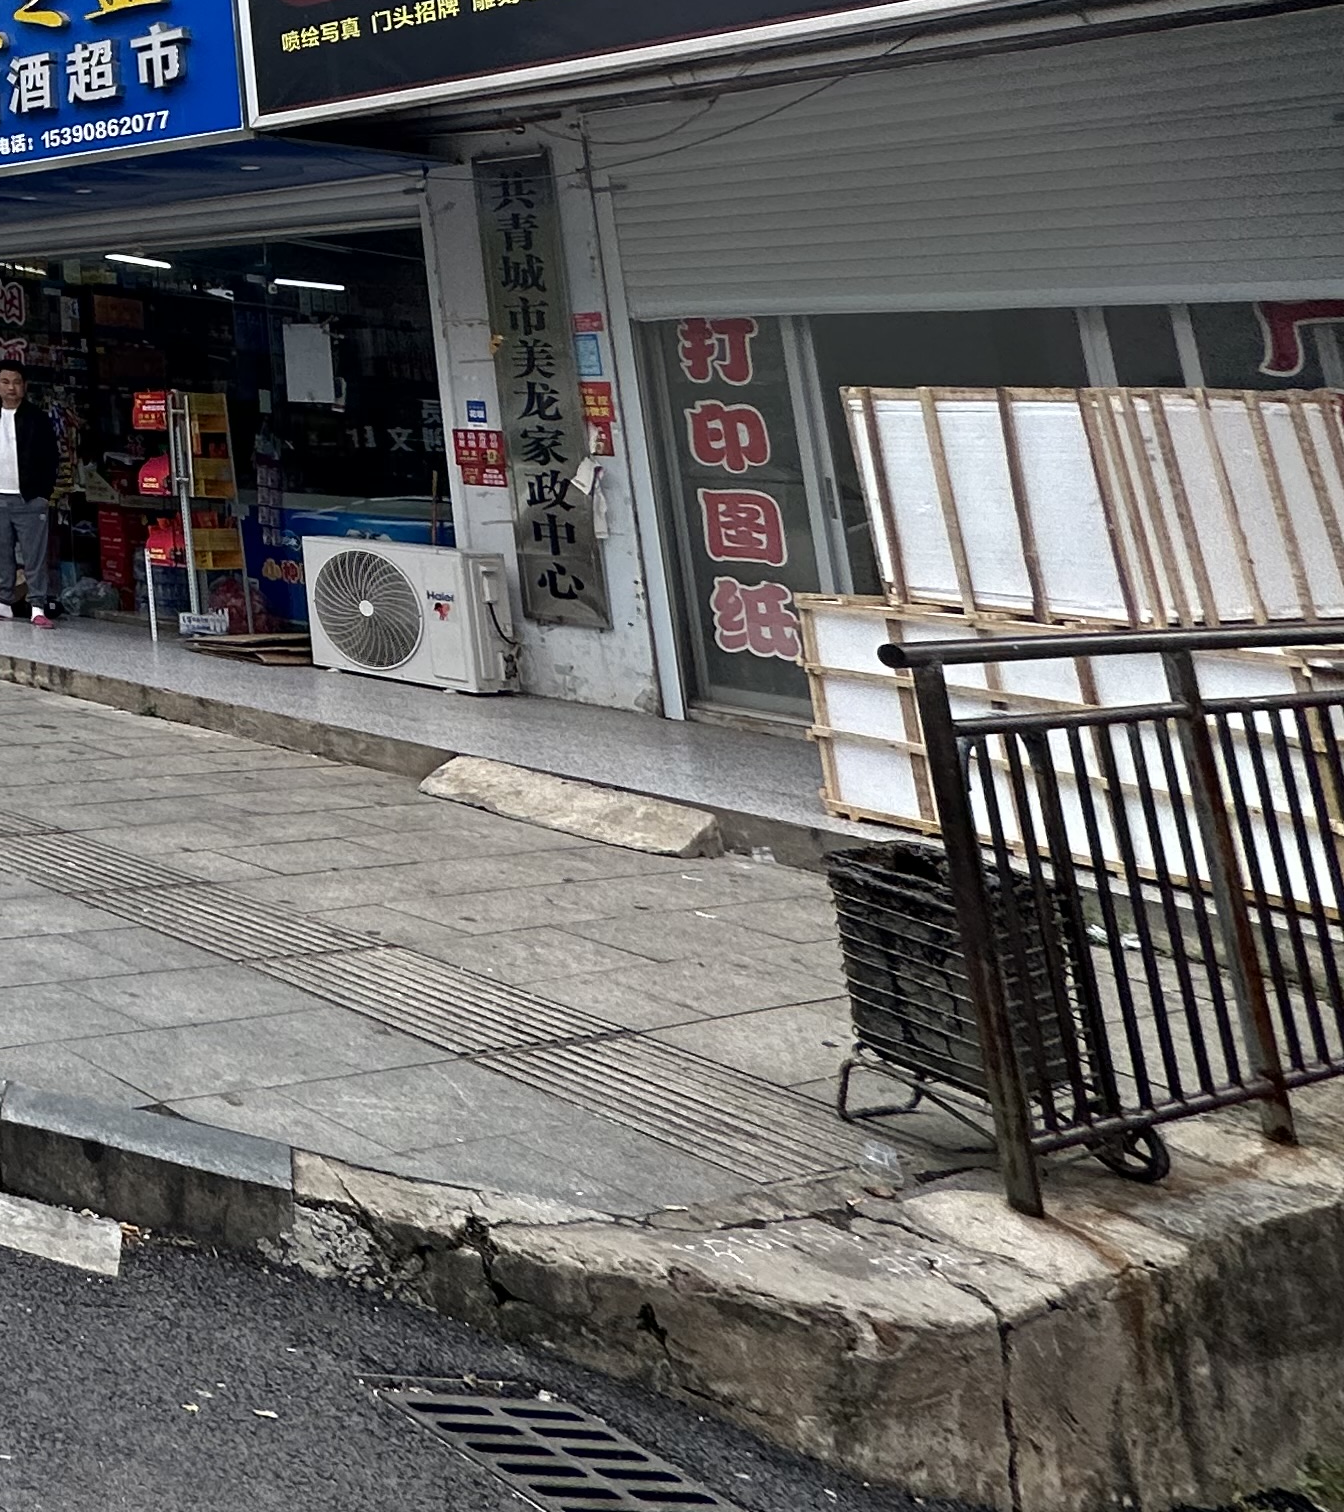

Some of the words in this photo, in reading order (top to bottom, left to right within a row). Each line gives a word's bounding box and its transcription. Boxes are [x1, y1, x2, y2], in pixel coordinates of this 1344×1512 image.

[280, 17, 361, 54] 喷绘写真
[40, 109, 170, 149] 15390862077
[492, 172, 585, 601] 共青城市美龙家政中心
[679, 317, 803, 662] 打印图纸
[426, 590, 455, 602] Haier
